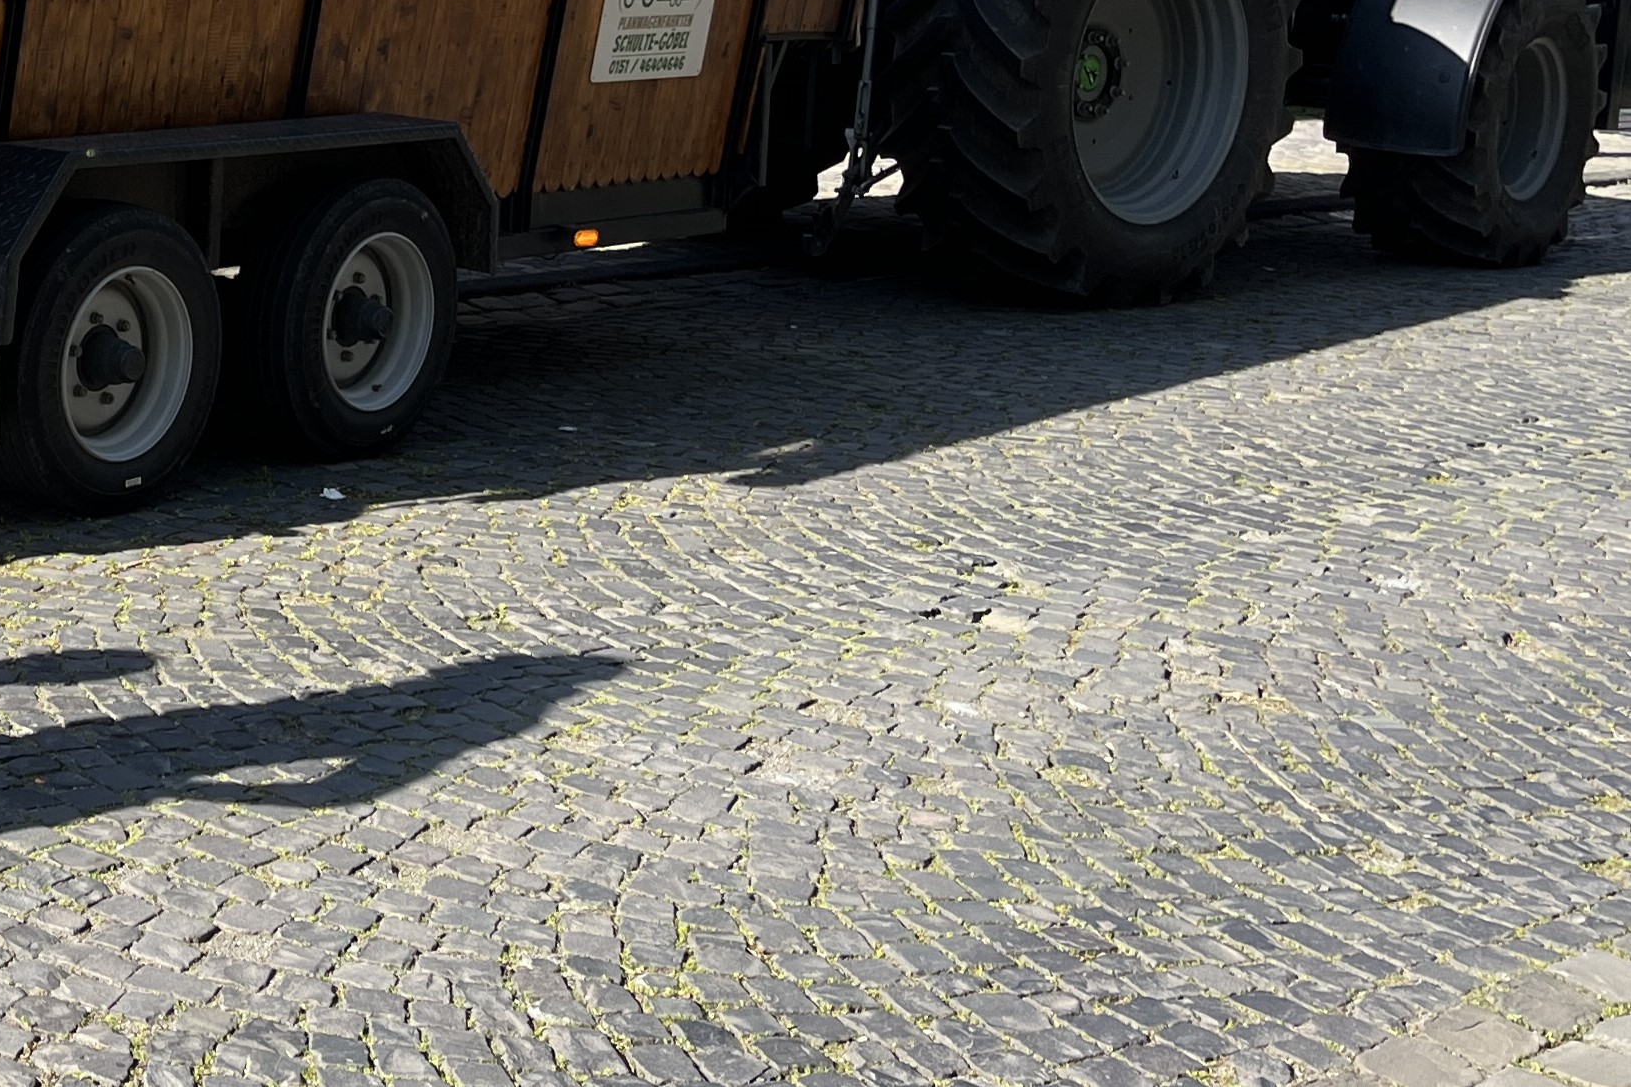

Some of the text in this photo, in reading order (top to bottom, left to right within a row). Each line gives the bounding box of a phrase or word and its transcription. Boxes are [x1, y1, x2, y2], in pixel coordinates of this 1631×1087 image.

[617, 13, 694, 31] PLANWAGENFAHRTEN
[612, 28, 691, 53] SCHULTE-GÖBEL
[608, 59, 631, 75] 0151
